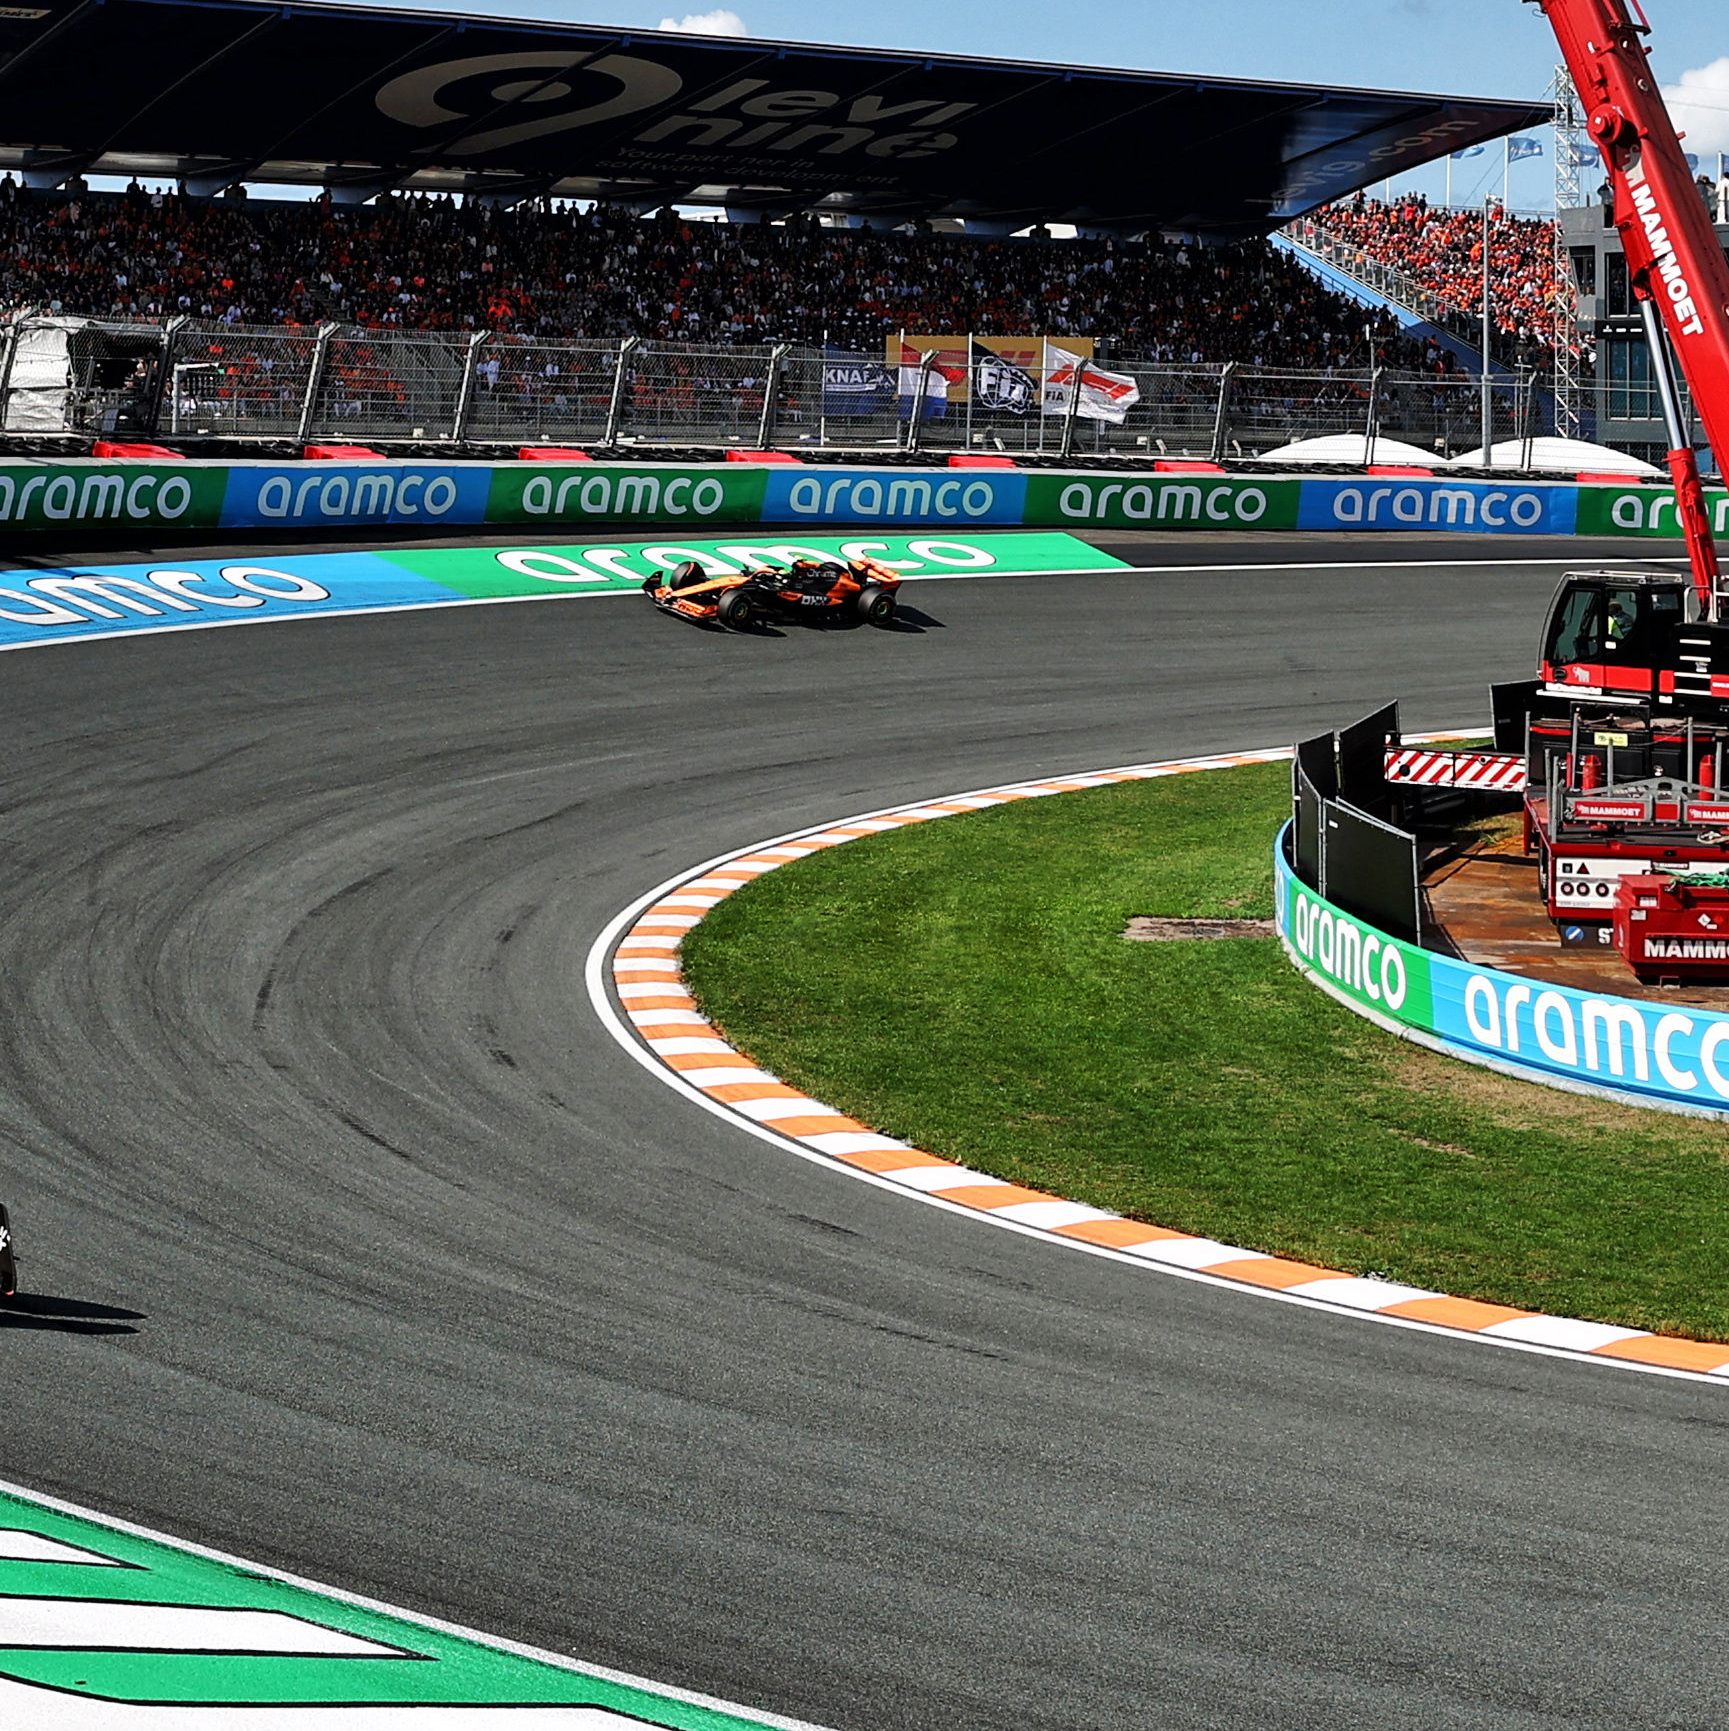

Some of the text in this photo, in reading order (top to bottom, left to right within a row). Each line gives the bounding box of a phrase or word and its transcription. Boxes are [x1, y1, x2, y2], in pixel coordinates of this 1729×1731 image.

[687, 79, 978, 127] levi
[633, 114, 959, 159] nine
[1631, 182, 1704, 336] MAMMOET
[256, 475, 457, 518] aramco
[521, 475, 725, 517] aramco
[790, 479, 994, 518] aramco
[1059, 481, 1268, 523] aramco
[1333, 486, 1543, 528] aramco
[806, 568, 838, 579] Chrome
[1590, 807, 1641, 817] MAMMOET
[1659, 862, 1689, 870] MAMMOET
[1294, 892, 1407, 1011] aramco
